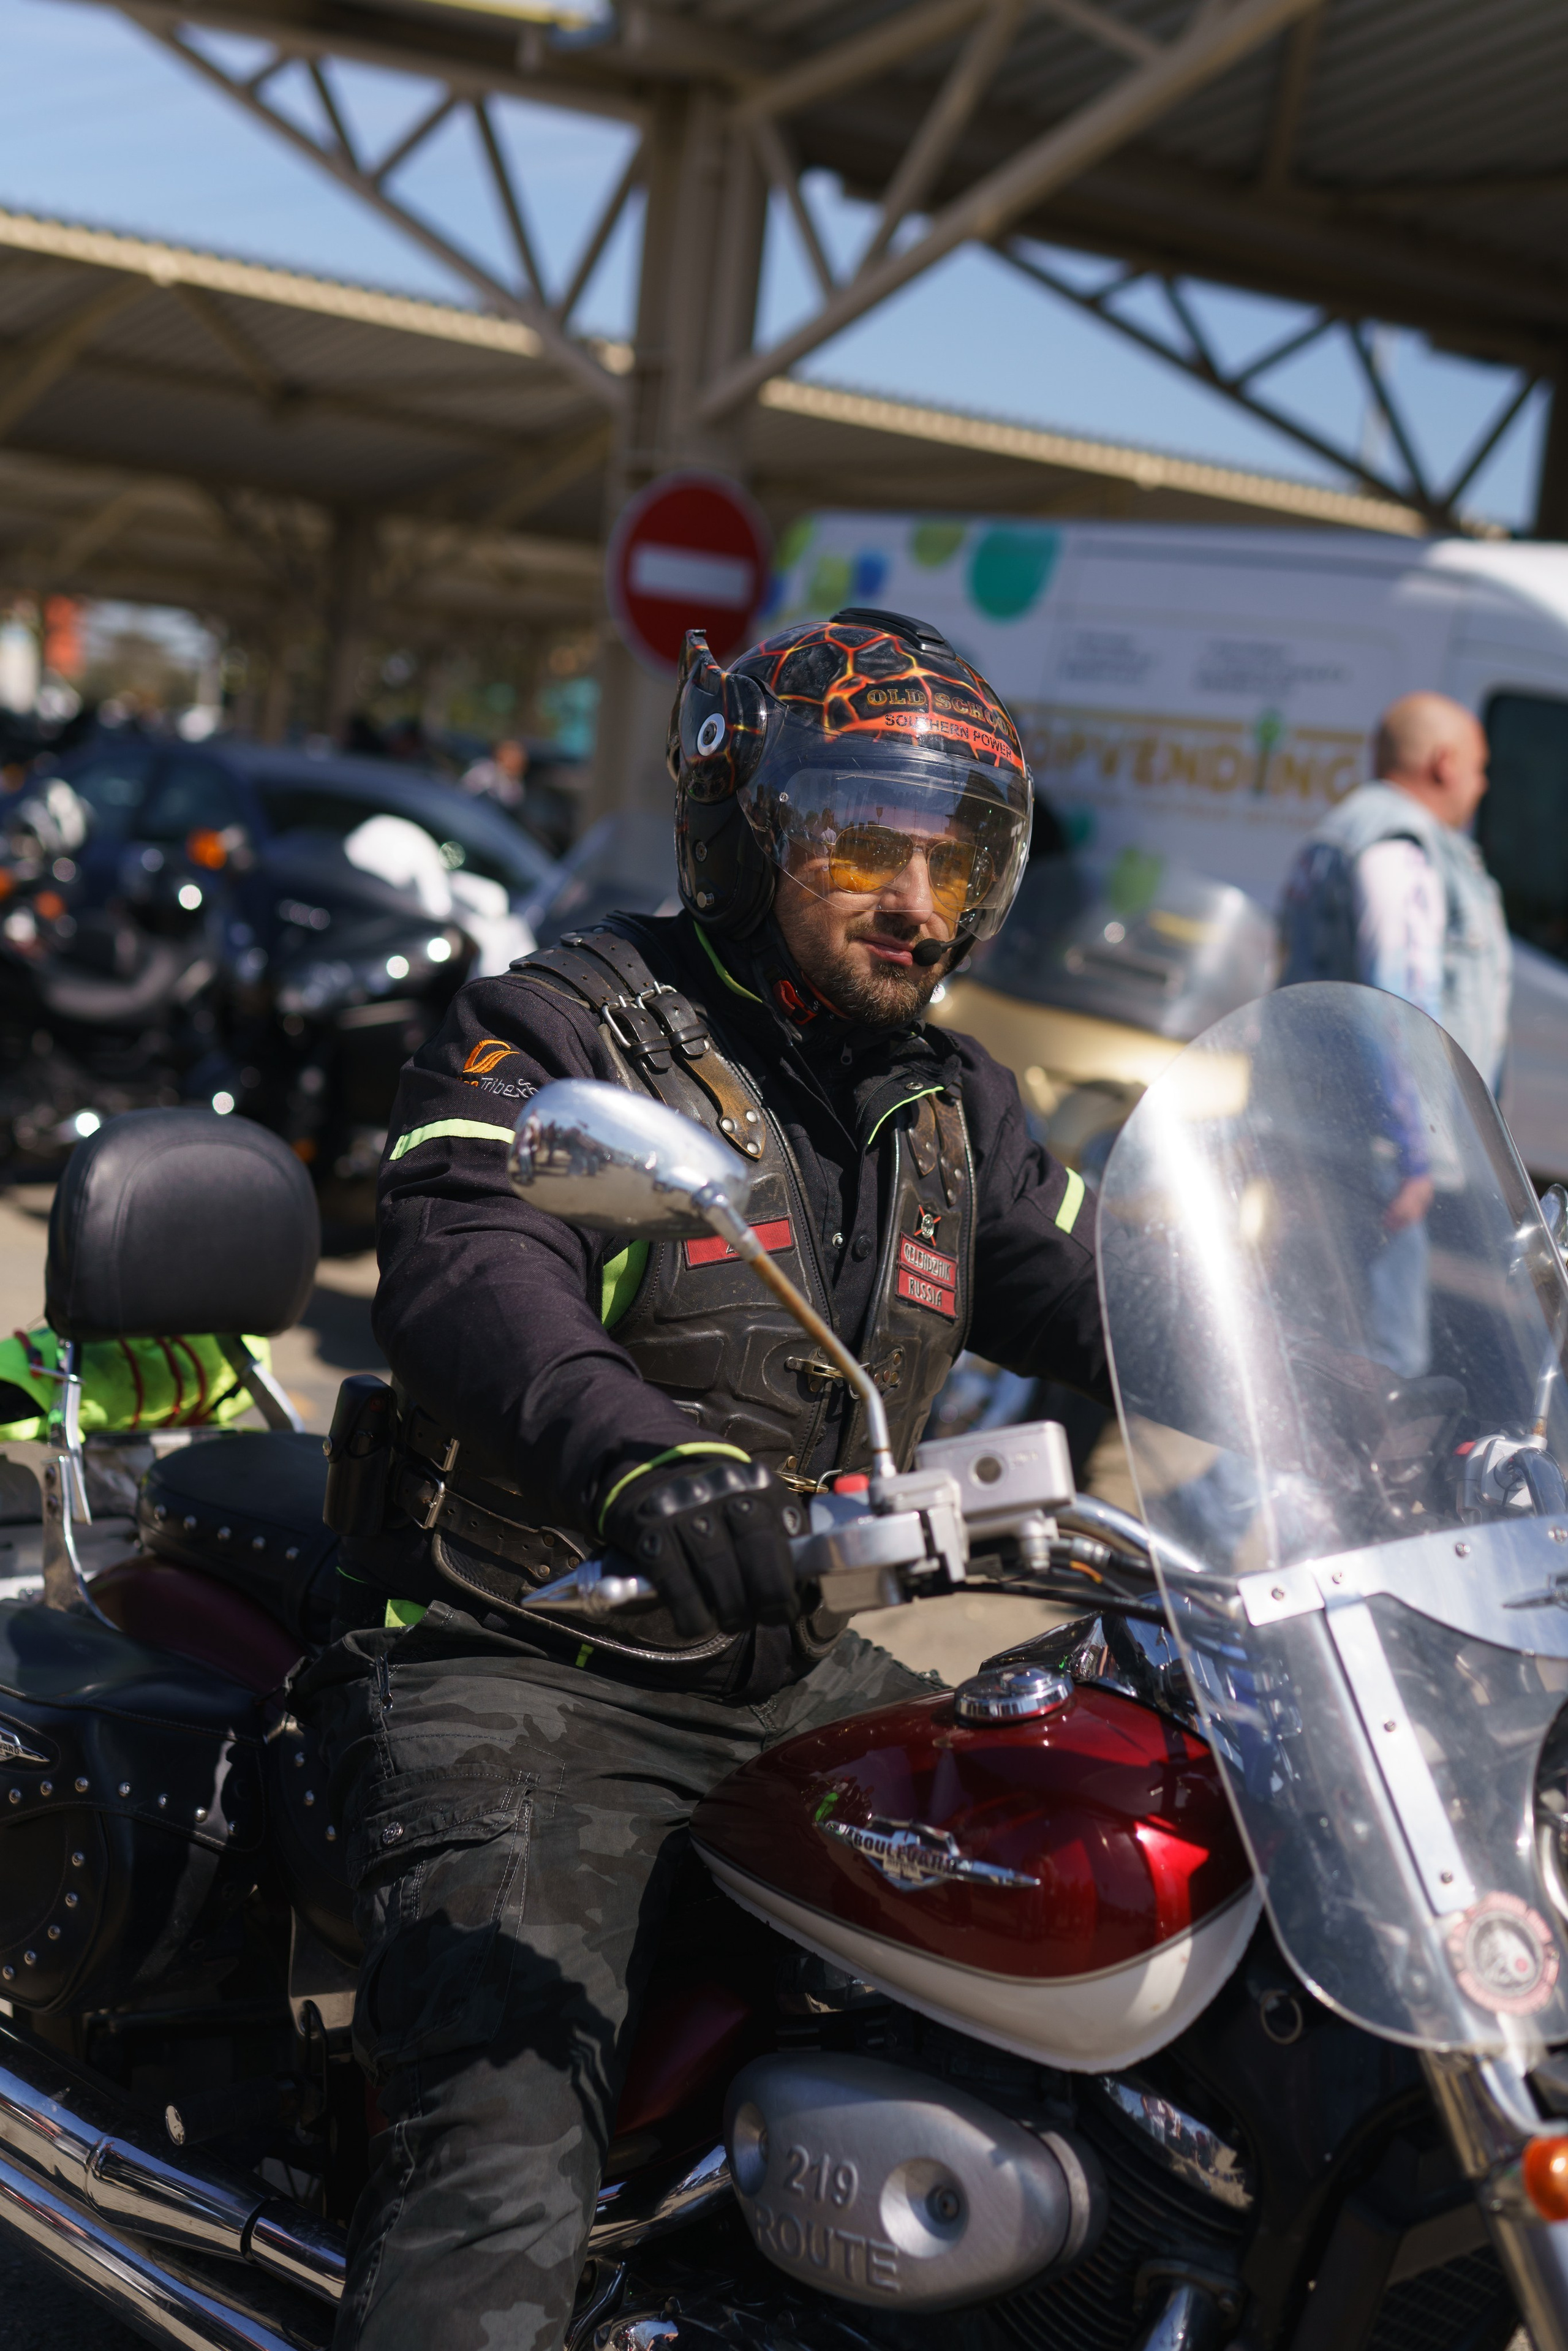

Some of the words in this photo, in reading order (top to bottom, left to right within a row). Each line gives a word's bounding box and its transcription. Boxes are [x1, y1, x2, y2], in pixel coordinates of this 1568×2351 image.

[867, 689, 926, 704] OLD
[934, 692, 1017, 745] SCHOOL
[973, 730, 1012, 760] POWER
[904, 1243, 951, 1280] GELENDZHIK
[908, 1277, 943, 1307] RUSSIA
[785, 2145, 858, 2208] 219
[756, 2202, 900, 2291] ROUTE
